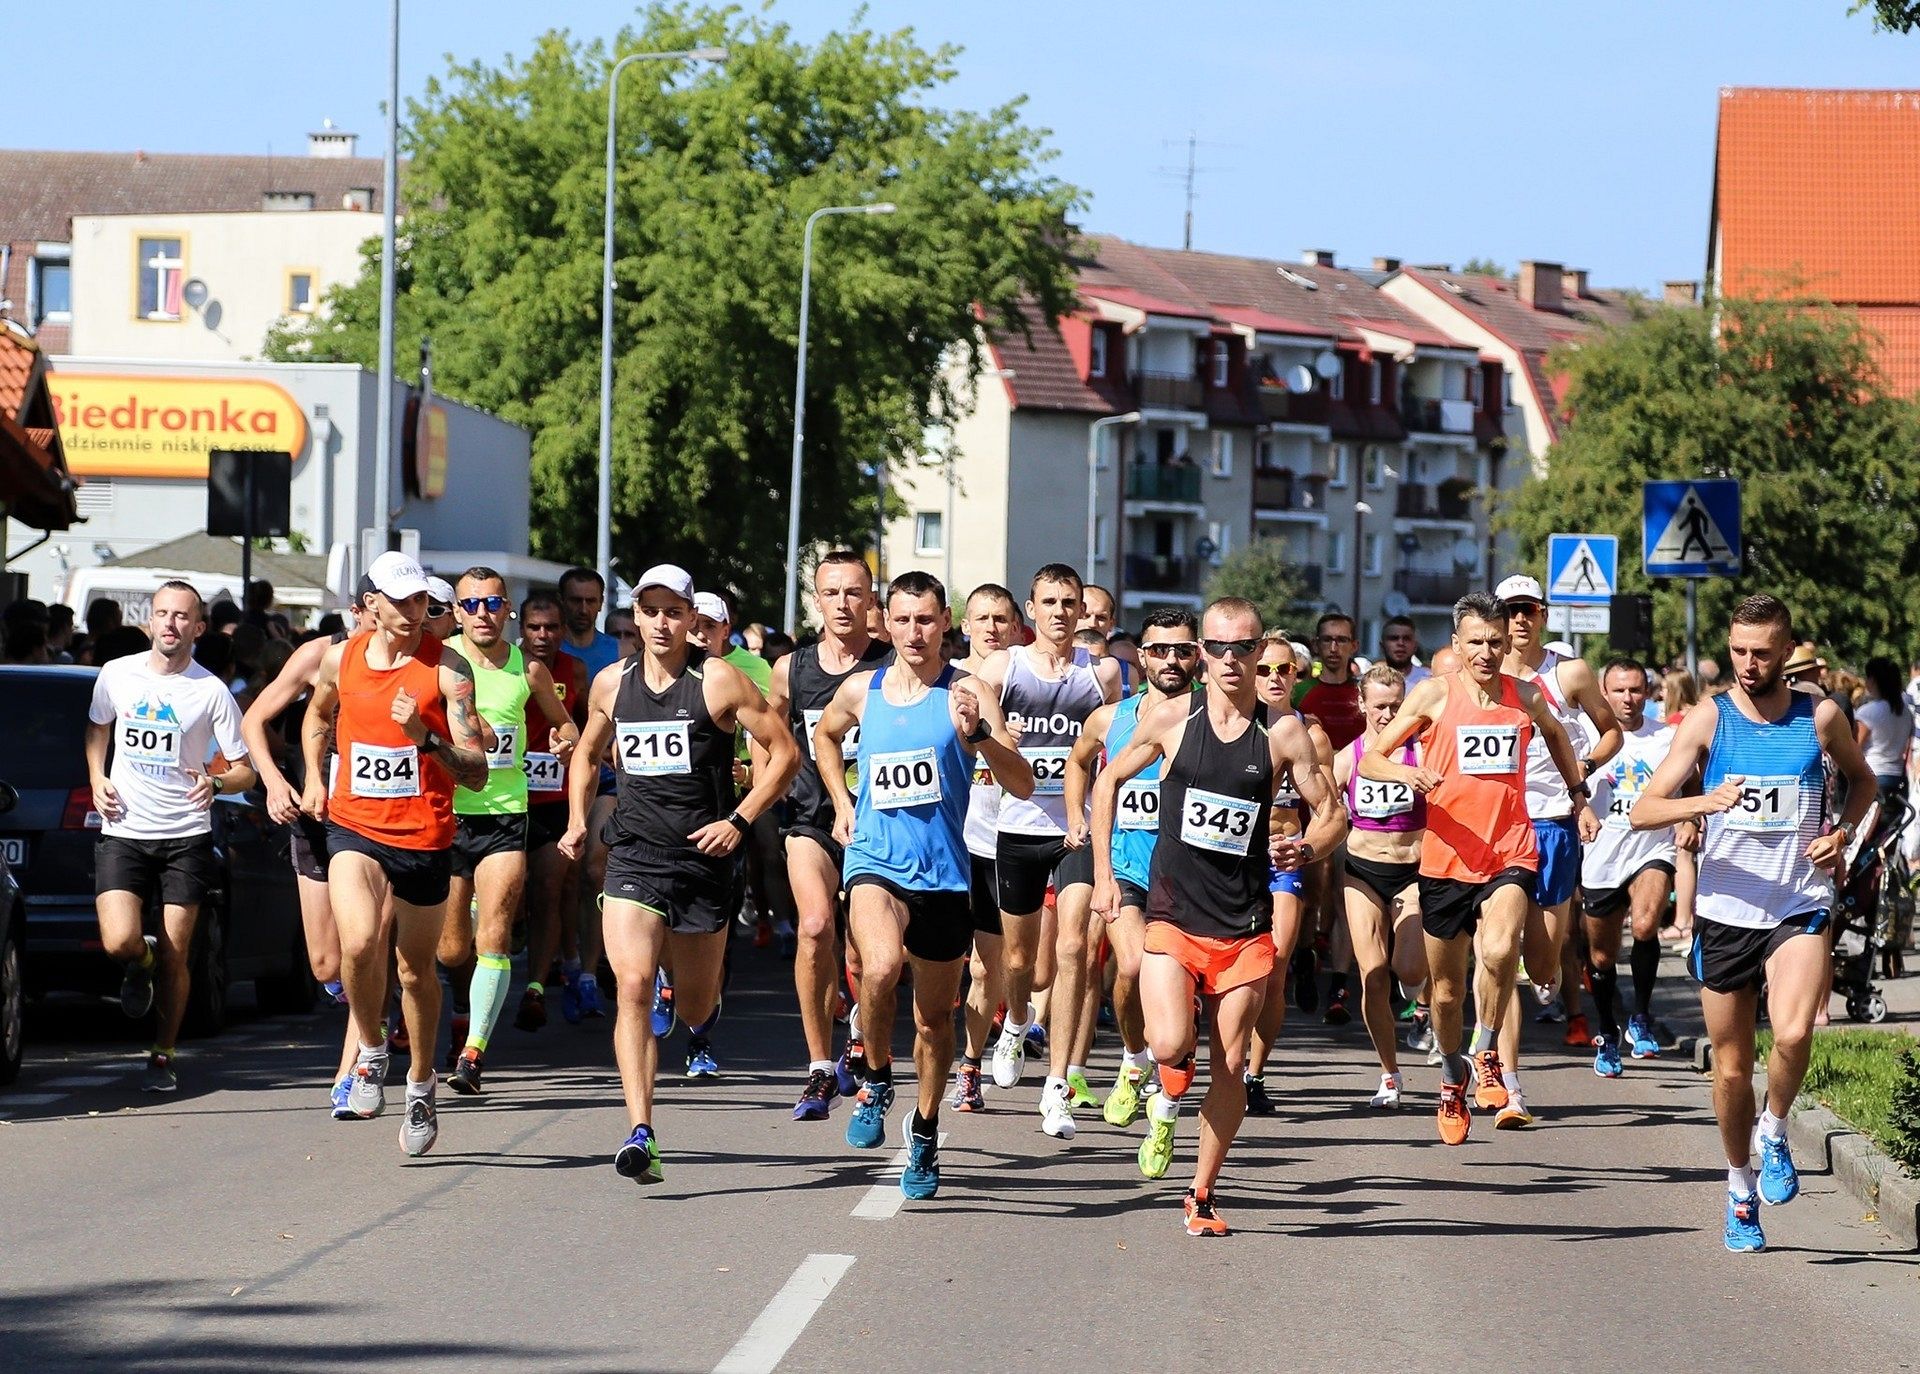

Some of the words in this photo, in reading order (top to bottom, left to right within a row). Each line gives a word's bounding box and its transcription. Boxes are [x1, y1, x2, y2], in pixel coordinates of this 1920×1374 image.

[125, 728, 173, 752] 501
[623, 733, 683, 758] 216
[1463, 735, 1517, 758] 207
[356, 756, 414, 781] 284
[522, 760, 559, 779] 241
[875, 761, 933, 790] 400
[1032, 757, 1067, 780] 62
[1361, 784, 1409, 804] 312
[1742, 787, 1779, 813] 51
[1188, 802, 1251, 837] 343
